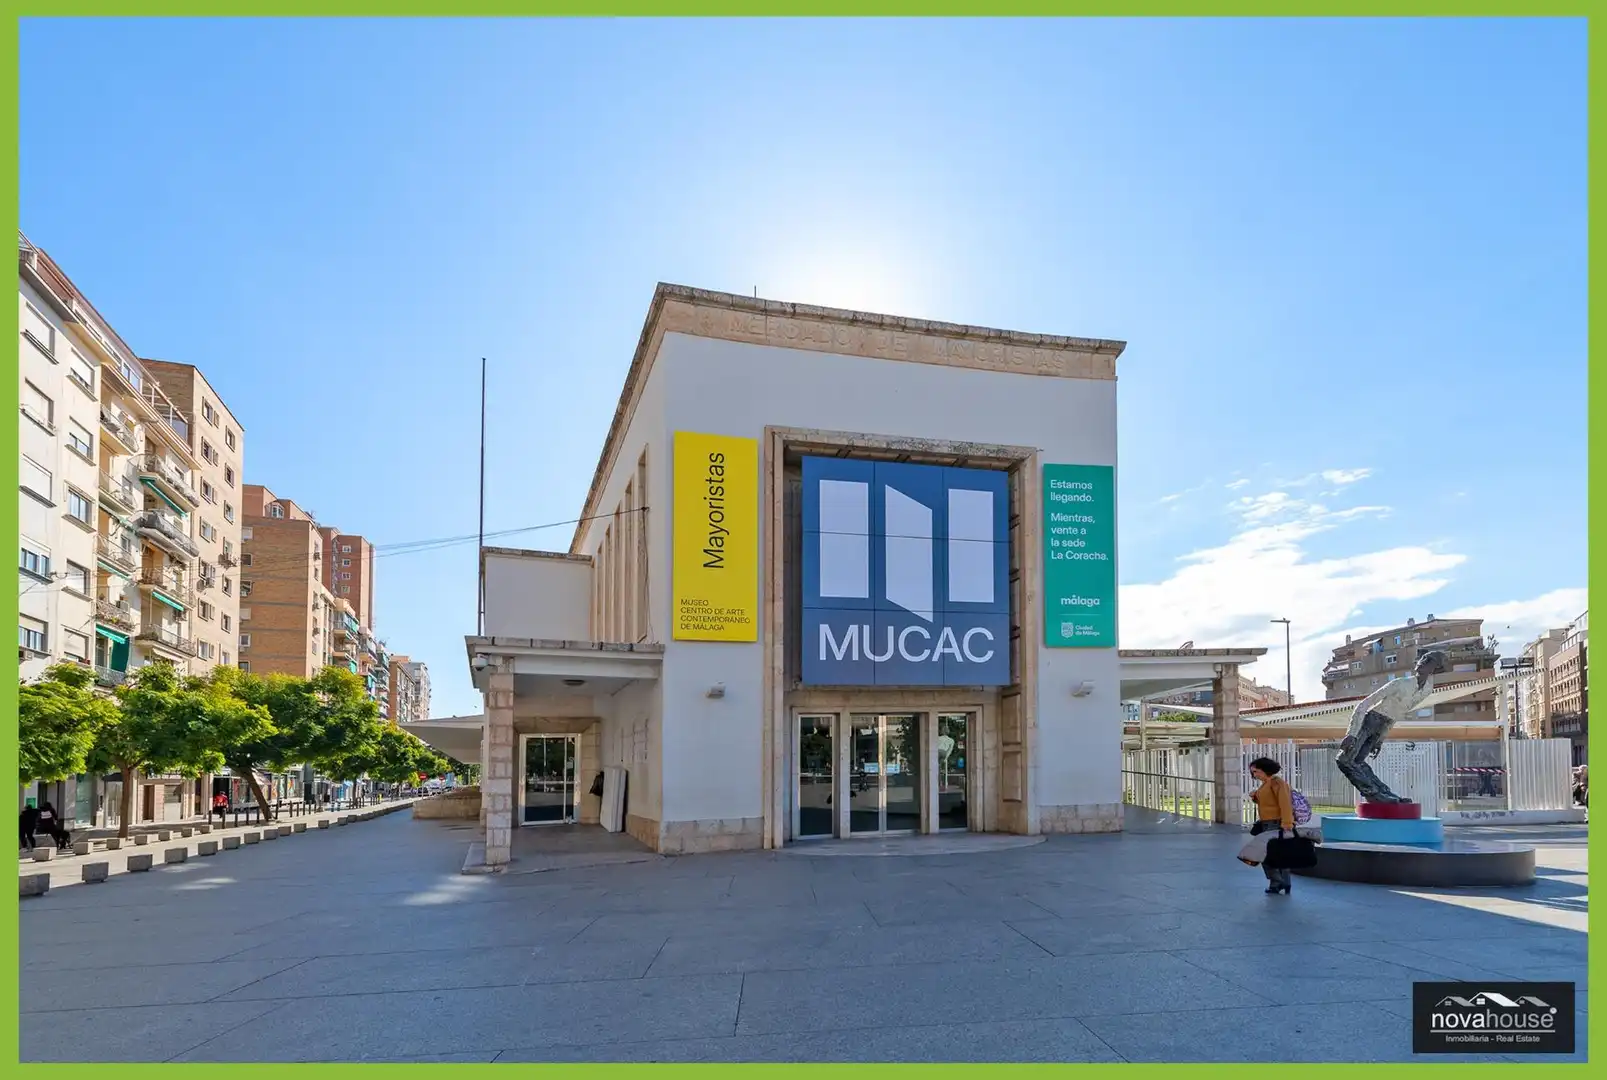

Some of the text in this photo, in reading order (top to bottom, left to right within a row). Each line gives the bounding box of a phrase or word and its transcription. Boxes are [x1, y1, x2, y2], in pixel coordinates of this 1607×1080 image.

[729, 314, 852, 346] MERCADO
[933, 338, 1065, 370] MAYORISTAS
[1050, 479, 1093, 490] Estamos
[1050, 492, 1095, 504] llegando.
[703, 452, 729, 569] Mayoristas
[1050, 512, 1096, 524] Mientras,
[1050, 526, 1087, 535] vente a
[1050, 538, 1086, 548] la sede
[1051, 550, 1109, 561] La Coracha.
[680, 599, 709, 607] MUSEO
[680, 606, 745, 616] CENTRO DE ARTE
[680, 623, 691, 631] DE
[819, 624, 994, 663] MUCAC
